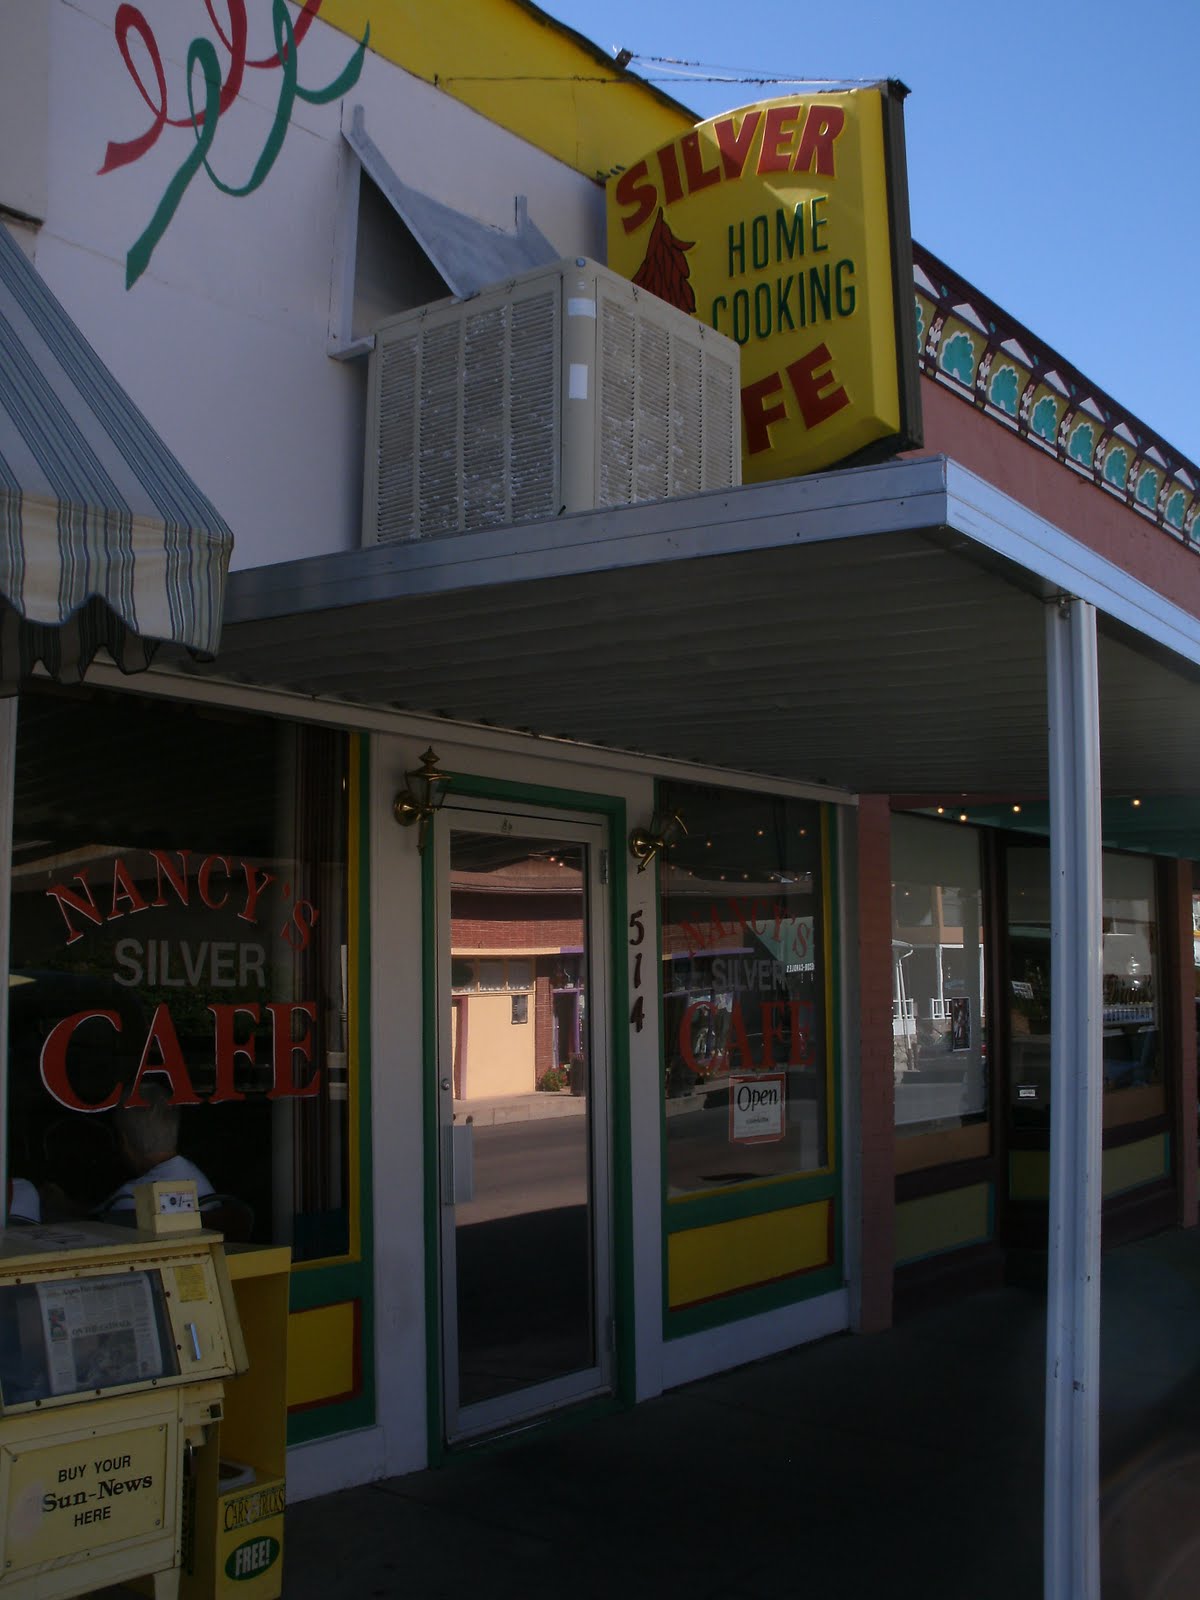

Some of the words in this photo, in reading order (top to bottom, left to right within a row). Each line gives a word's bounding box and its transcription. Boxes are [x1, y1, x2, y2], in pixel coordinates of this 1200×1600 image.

[615, 104, 845, 235] SILVER
[727, 195, 829, 278] HOME
[711, 258, 857, 346] COOKING
[740, 342, 851, 455] FE
[46, 849, 320, 951] NANCY'S
[679, 896, 812, 959] NANCY'S
[112, 938, 267, 988] SILVER
[711, 957, 791, 992] SILVER
[40, 1001, 322, 1114] CAFE
[679, 1000, 816, 1074] CAFE
[737, 1086, 778, 1112] Open
[42, 1475, 153, 1513] Sun-News
[58, 1464, 87, 1483] BUY
[94, 1455, 131, 1474] YOUR
[74, 1506, 111, 1527] HERE
[224, 1500, 249, 1531] CARS
[234, 1538, 271, 1578] FREE!
